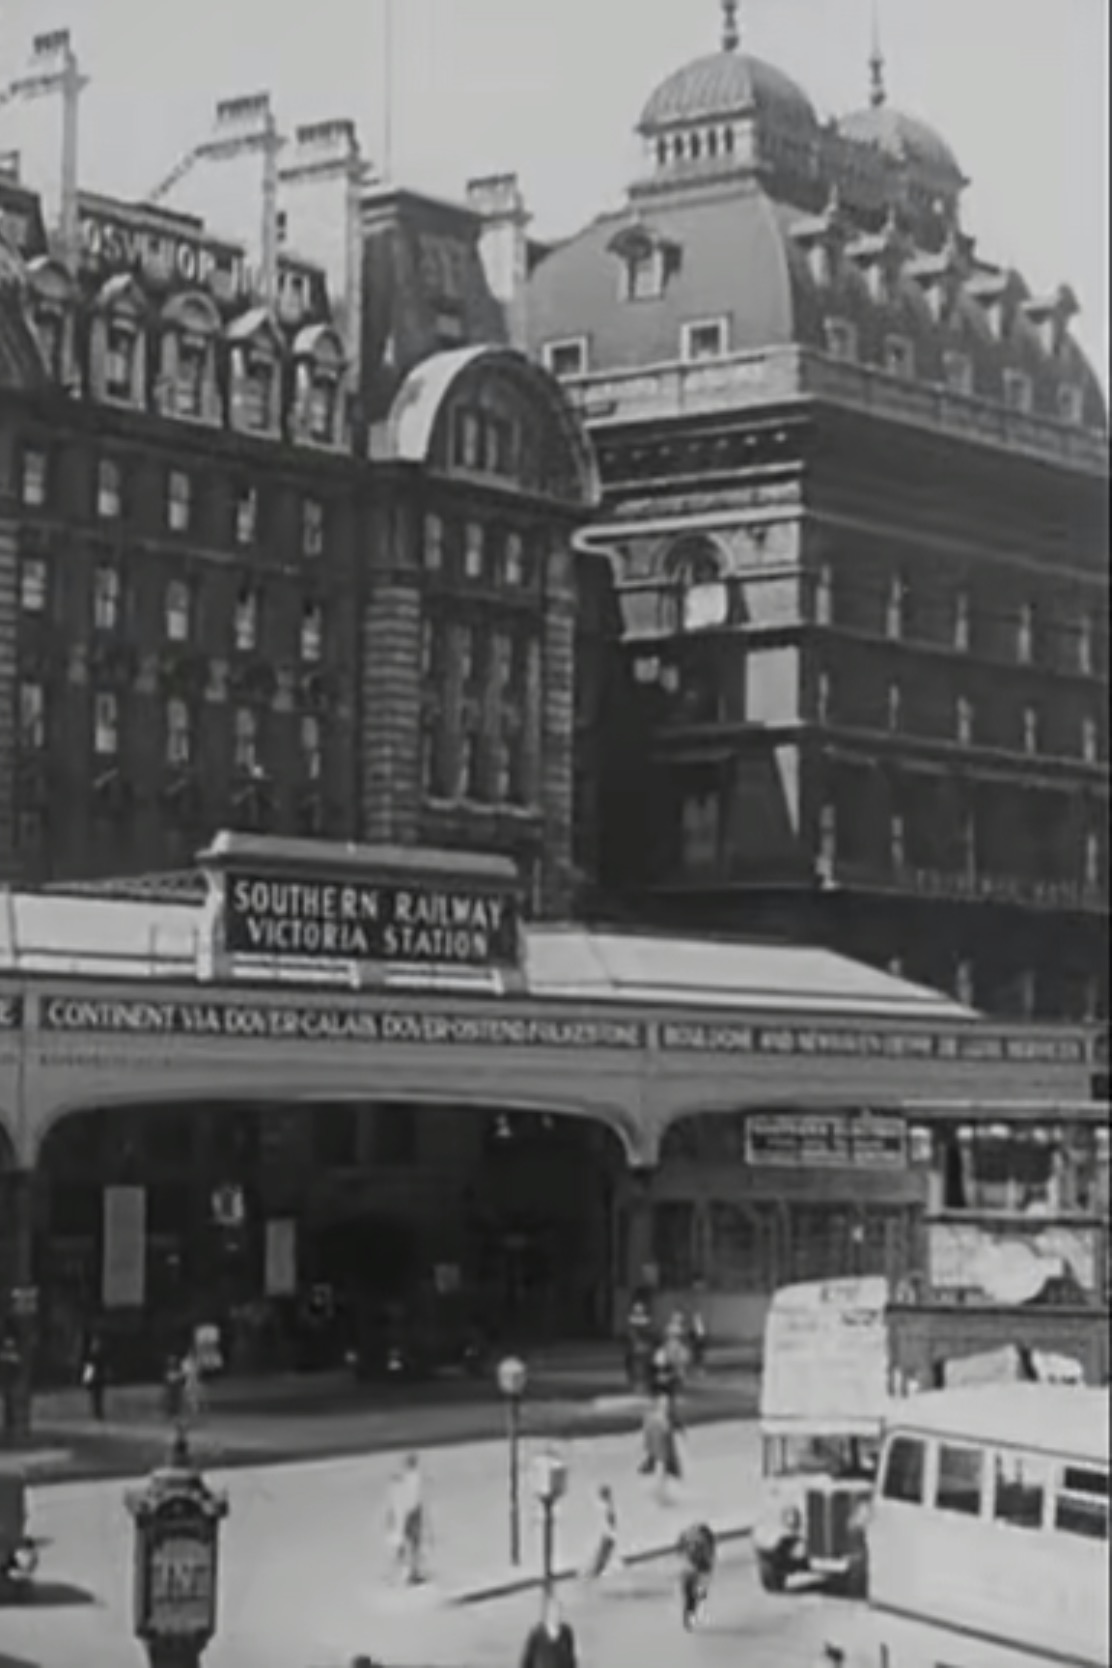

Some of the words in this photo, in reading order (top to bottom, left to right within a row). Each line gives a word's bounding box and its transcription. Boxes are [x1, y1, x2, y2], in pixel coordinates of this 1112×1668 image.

[234, 879, 378, 920] SOUTHERN
[395, 891, 502, 930] RAILWAY
[246, 917, 368, 952] VICTORIA
[383, 925, 488, 958] STATION
[48, 1000, 175, 1028] CONTINENT
